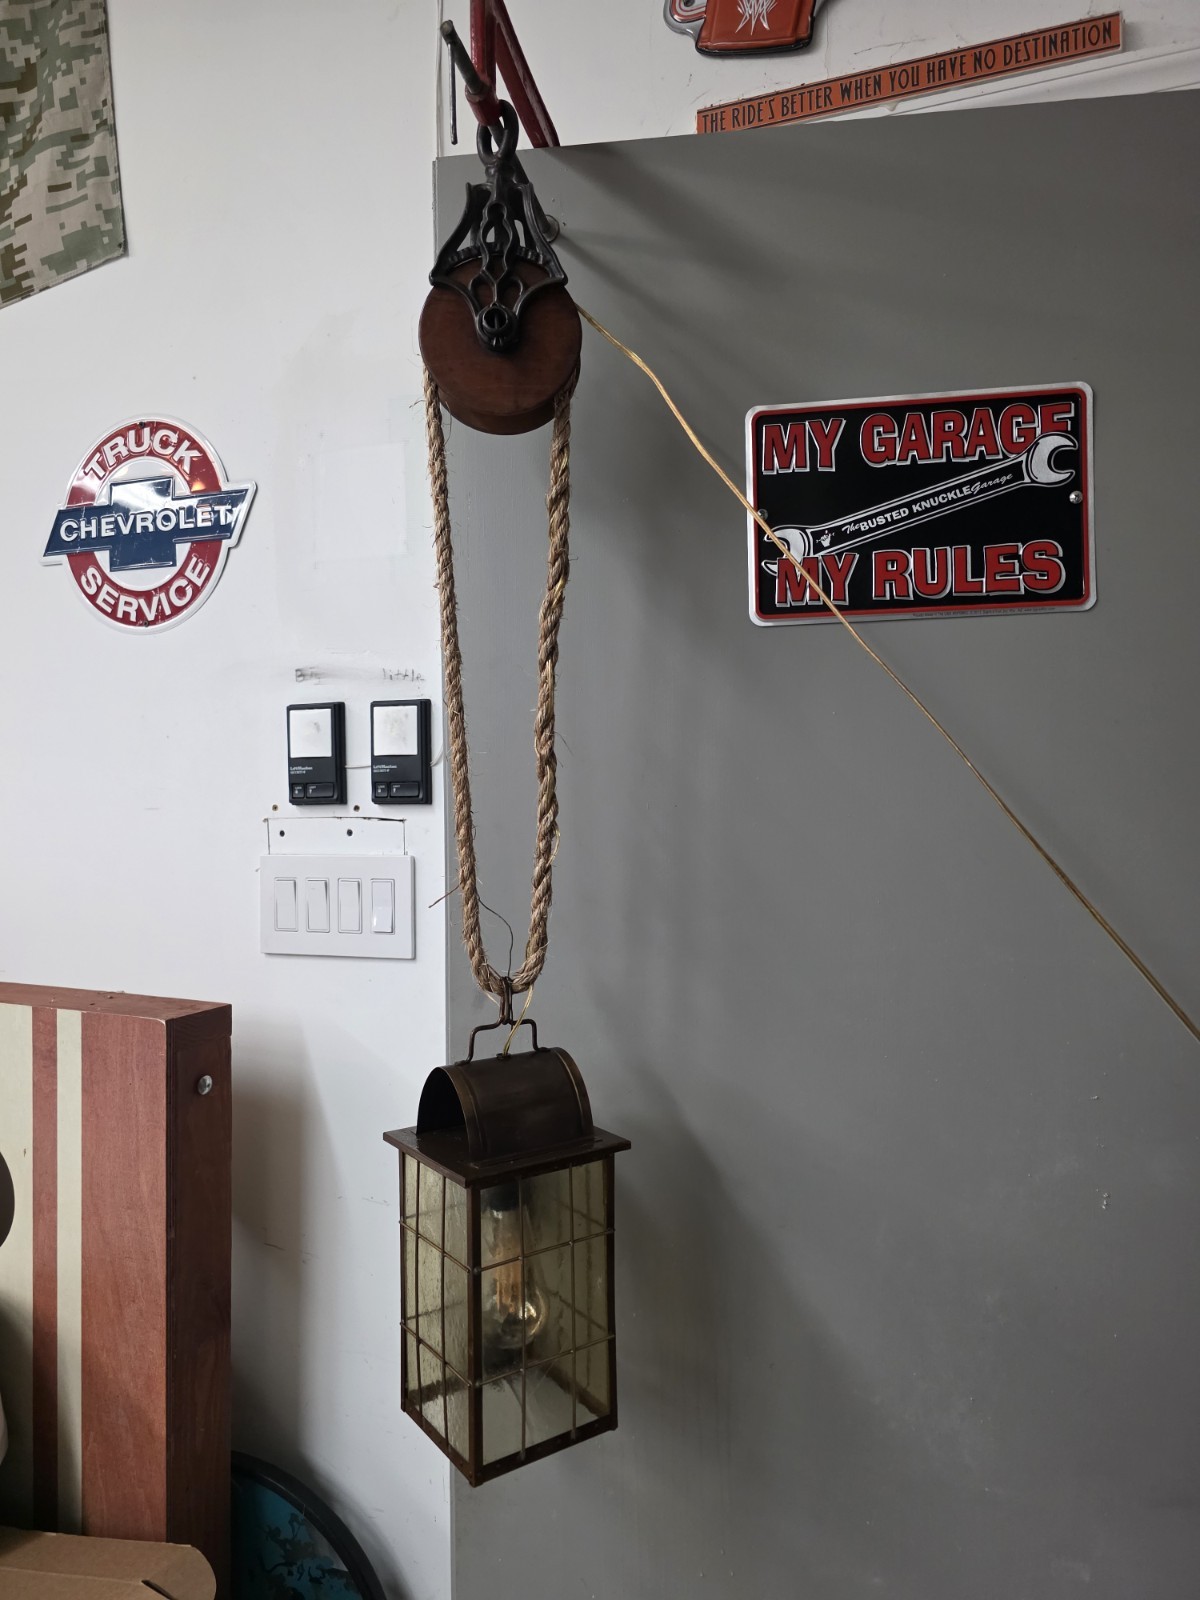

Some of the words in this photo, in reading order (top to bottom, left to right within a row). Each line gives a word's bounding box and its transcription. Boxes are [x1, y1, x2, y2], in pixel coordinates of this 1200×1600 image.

[702, 110, 726, 133] THE
[732, 98, 775, 128] RIDE'S
[781, 86, 833, 117] BETTER
[840, 74, 882, 103] WHEN
[889, 66, 921, 92] YOU
[927, 54, 967, 84] HAVE
[973, 48, 996, 73] NO
[1003, 21, 1112, 66] DESTINATION
[84, 427, 203, 480] TRUCK
[762, 418, 846, 475] MY
[860, 402, 1075, 468] GARAGE
[60, 505, 232, 542] CHEVROLET
[842, 522, 860, 534] The
[859, 507, 909, 531] BUSTED
[912, 486, 972, 514] KNUCKLE
[970, 473, 1013, 495] Garage
[81, 554, 210, 622] SERVICE
[775, 552, 859, 607] MY
[872, 540, 1067, 600] RULES
